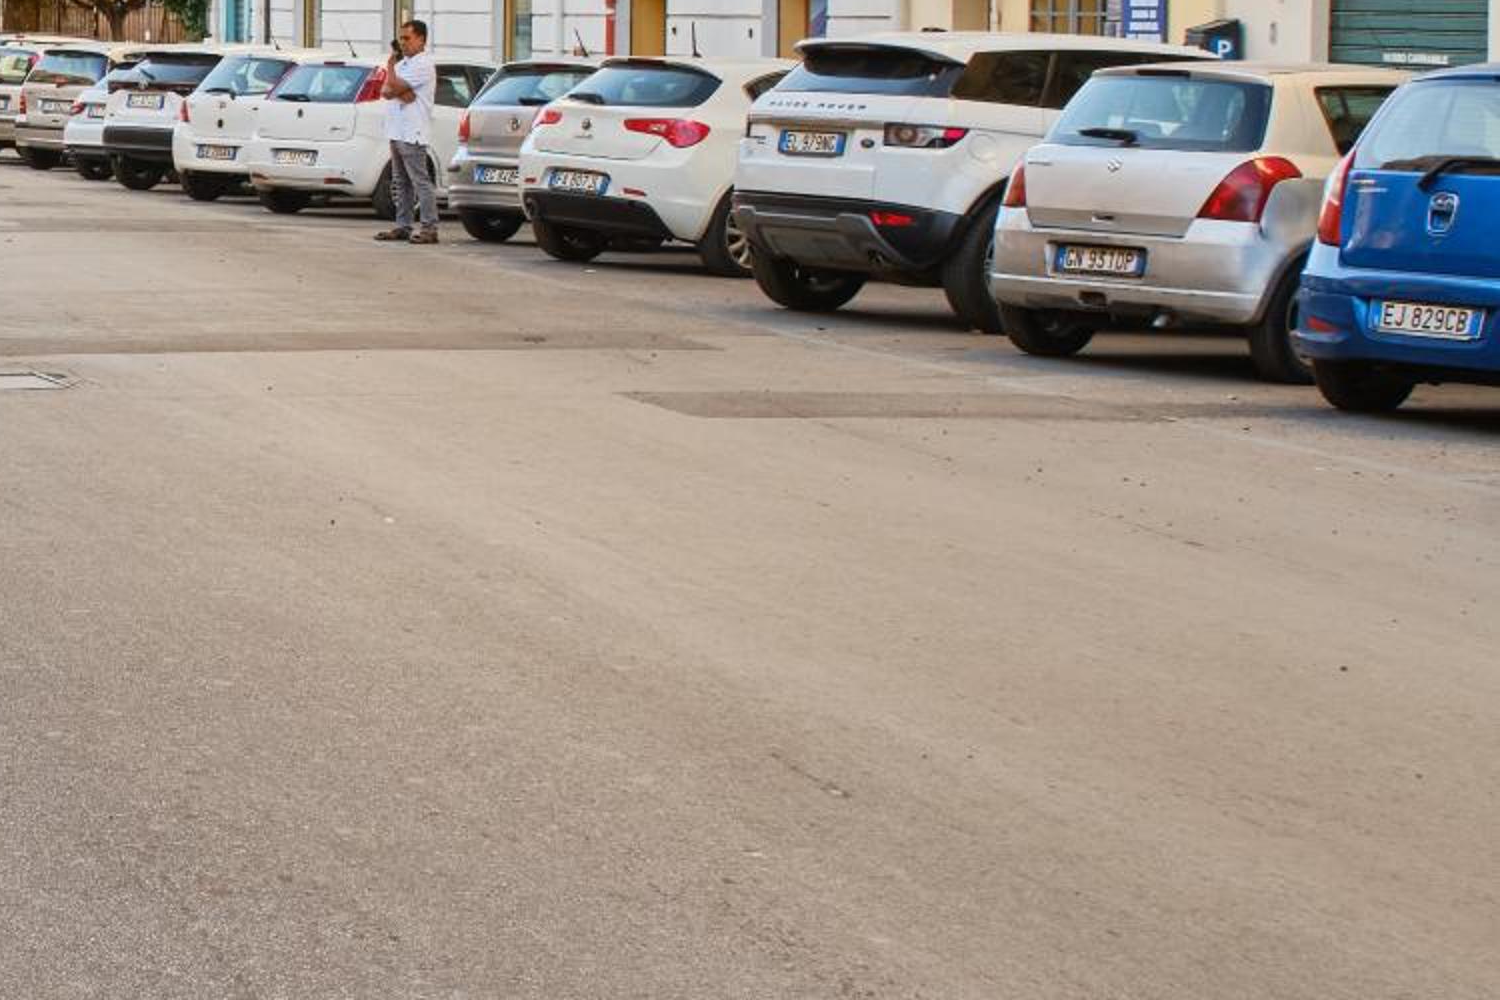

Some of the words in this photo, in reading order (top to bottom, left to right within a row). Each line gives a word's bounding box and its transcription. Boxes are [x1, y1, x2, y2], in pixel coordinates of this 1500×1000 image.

[1217, 40, 1233, 58] P
[1382, 303, 1406, 327] EJ
[1411, 307, 1469, 333] 829CB
